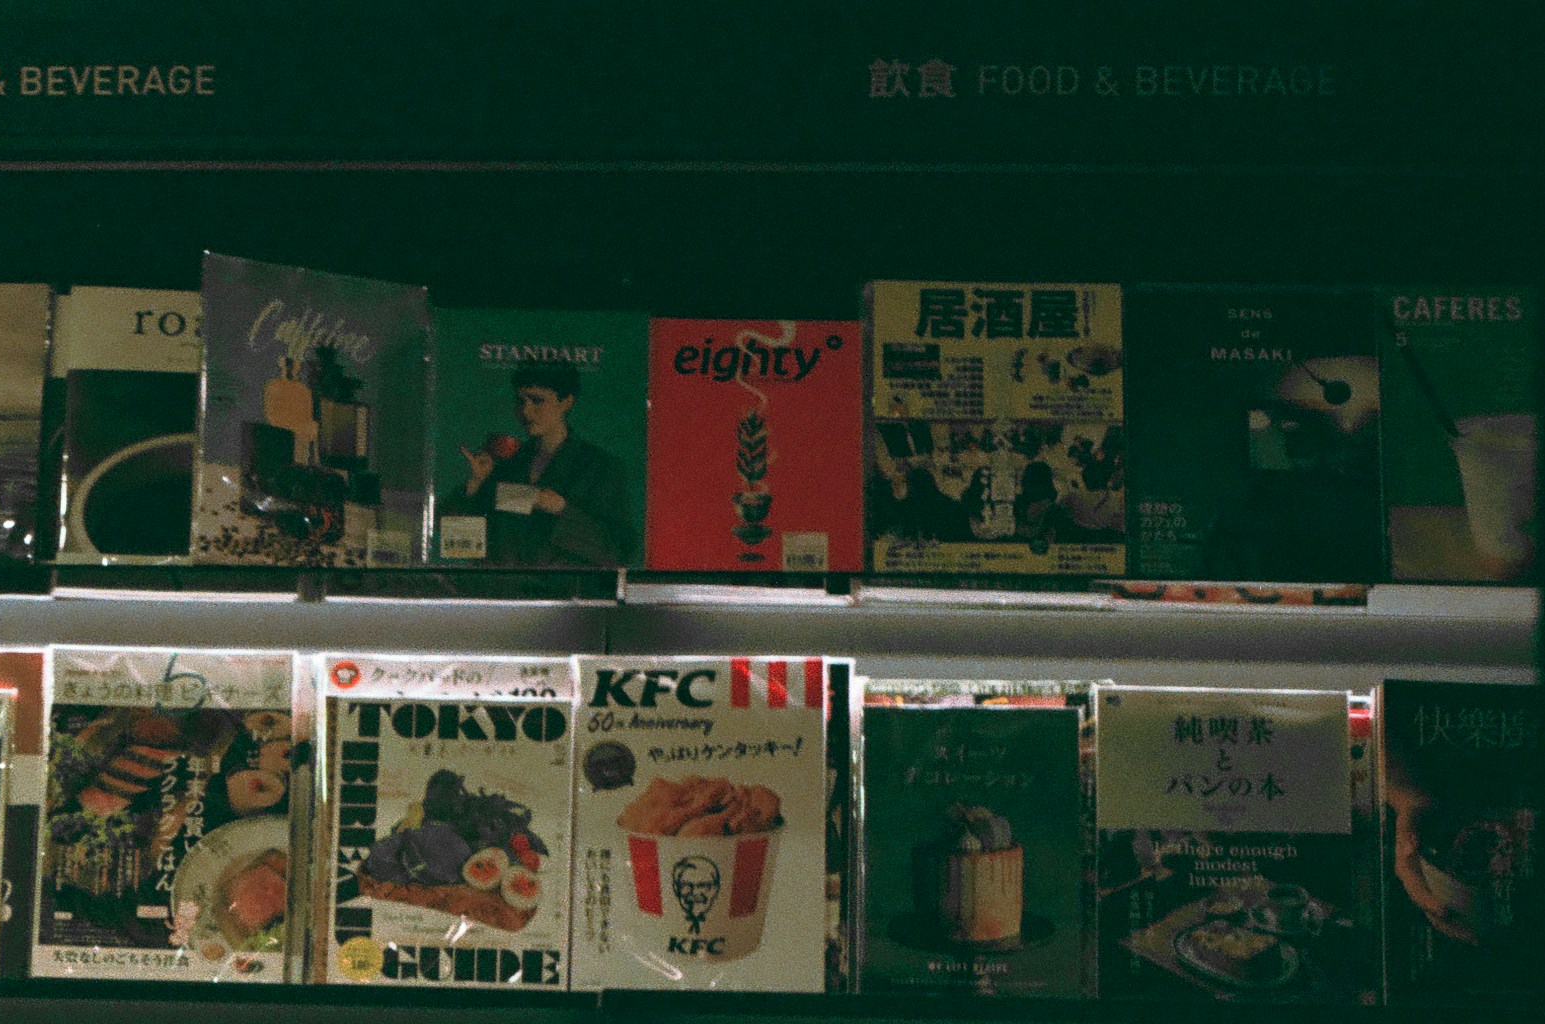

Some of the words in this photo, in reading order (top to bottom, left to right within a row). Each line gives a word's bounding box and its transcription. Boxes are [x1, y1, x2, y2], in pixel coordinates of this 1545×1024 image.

[21, 66, 215, 96] BEVERAGE
[868, 58, 956, 99] 飲食
[979, 65, 1080, 97] FOOD
[1094, 66, 1119, 97] &
[1136, 65, 1336, 97] BEVERAGE
[915, 289, 1078, 338] 居酒屋
[1392, 297, 1523, 322] CAFERES
[479, 343, 604, 364] STANDART
[1209, 346, 1293, 362] MASAKI
[588, 669, 716, 708] KFC
[349, 703, 567, 742] TOKYO
[629, 713, 713, 735] Anniversary
[1172, 715, 1274, 745] 純喫茶
[1215, 750, 1232, 772] と
[1165, 773, 1286, 801] パンの本
[666, 938, 725, 955] KFC
[382, 946, 560, 984] GUIDE
